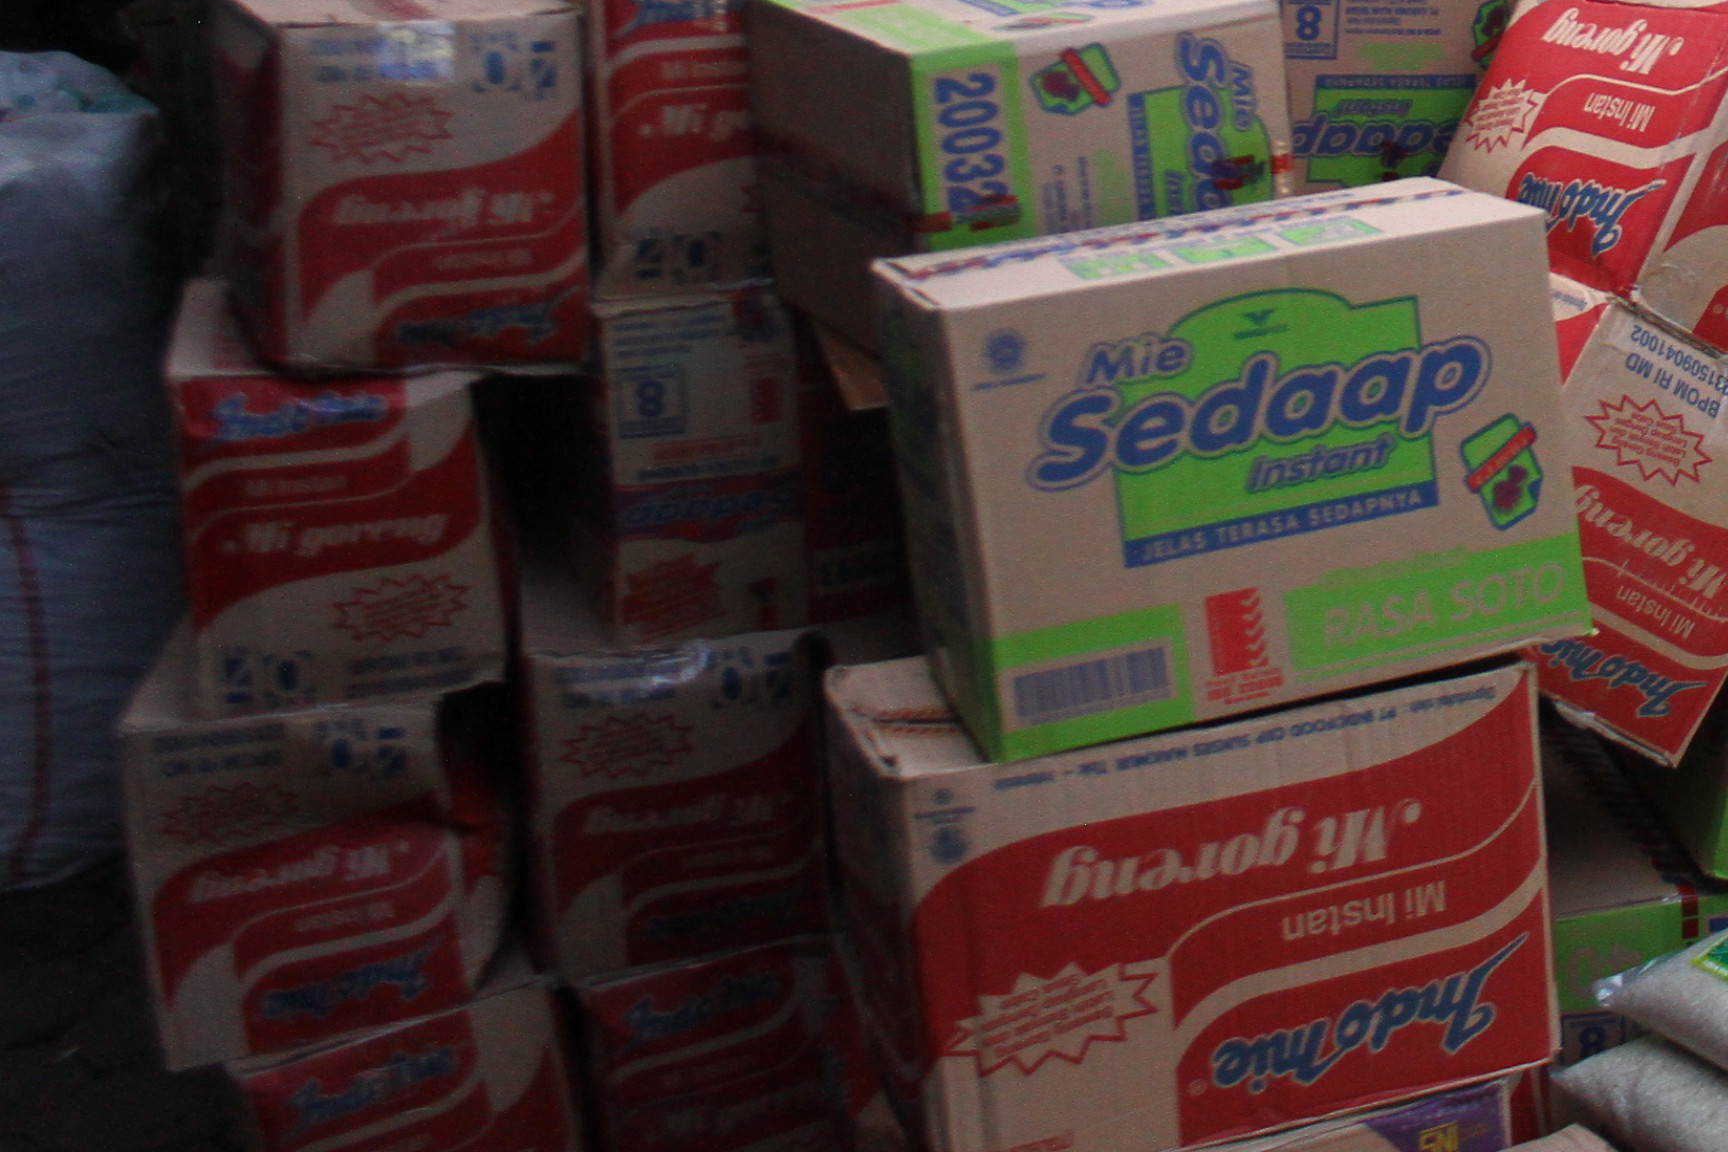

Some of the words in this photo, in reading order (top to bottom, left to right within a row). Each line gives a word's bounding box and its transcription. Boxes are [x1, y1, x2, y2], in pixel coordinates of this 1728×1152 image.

[1295, 4, 1322, 41] 8
[1540, 6, 1649, 57] goreng
[1228, 60, 1256, 133] Mie
[1583, 92, 1633, 128] Instan
[1631, 105, 1656, 134] Mi
[1078, 330, 1195, 388] Mie
[1624, 351, 1655, 380] MD
[1653, 367, 1675, 391] RI
[1027, 335, 1494, 492] Sedaap
[1672, 379, 1722, 420] BPOM
[1245, 431, 1396, 495] Instant
[1141, 532, 1208, 563] JELAS
[1216, 515, 1299, 547] TERASA
[1308, 488, 1424, 527] SEDAPNYA
[1575, 483, 1695, 567] goreng
[1322, 586, 1437, 650] RASA
[1450, 561, 1566, 623] SOTO
[1615, 584, 1674, 627] Instan
[1669, 613, 1697, 639] Mi
[1038, 806, 1306, 909] goreng
[1282, 890, 1397, 942] Instan
[1402, 879, 1447, 917] Mi
